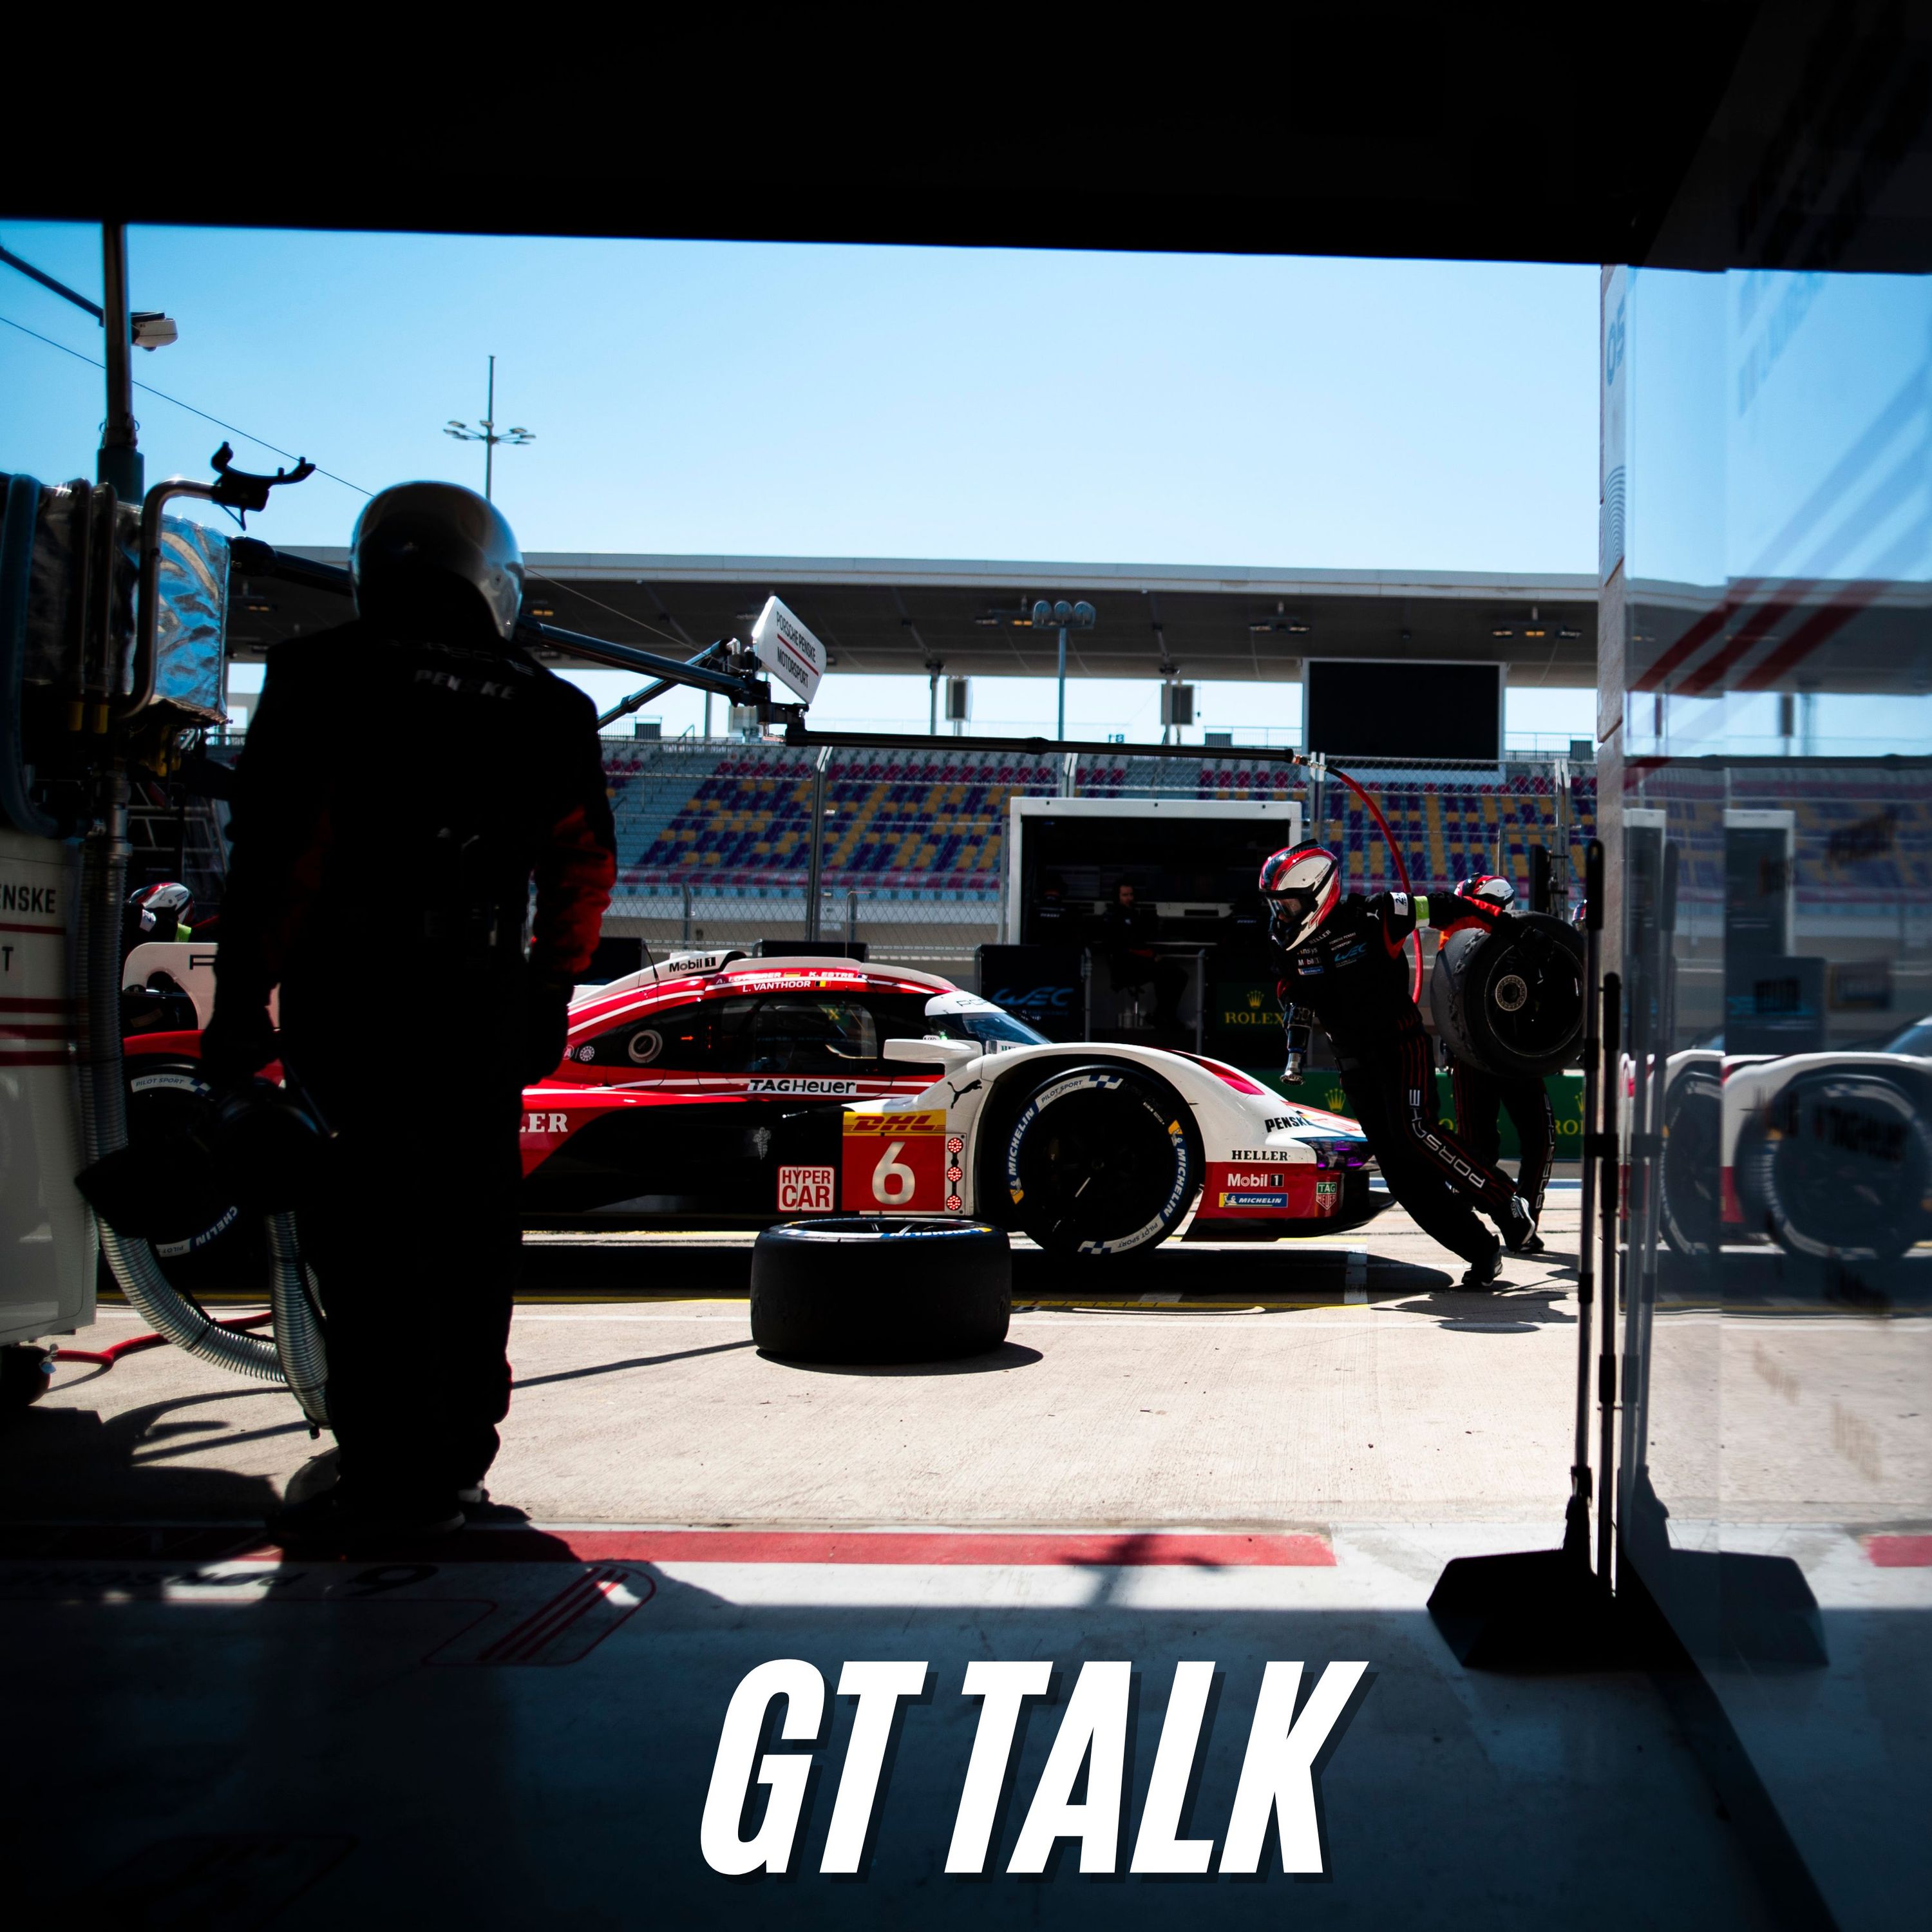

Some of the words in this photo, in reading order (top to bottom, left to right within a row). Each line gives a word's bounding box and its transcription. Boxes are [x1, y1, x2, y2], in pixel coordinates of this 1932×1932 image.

[777, 611, 799, 647] PORSCHE
[799, 632, 816, 663] PENSKE
[777, 646, 809, 688] MOTORSPORT
[0, 883, 57, 913] NSKE
[1, 946, 14, 971] T
[1334, 942, 1367, 961] WEC
[669, 958, 703, 972] Mobil
[728, 972, 782, 983] LORER
[753, 981, 811, 991] VANTHOOR
[992, 985, 1075, 1007] WEC
[136, 1078, 156, 1086] PILOT
[1041, 1088, 1058, 1103] PILOT
[1060, 1080, 1083, 1091] SPORT
[853, 1115, 935, 1131] DHL
[1265, 1116, 1312, 1133] PENSK
[1009, 1107, 1034, 1176] MICHELIN
[1408, 1089, 1486, 1189] PORSCHE
[1232, 1150, 1288, 1161] HELLER
[782, 1170, 831, 1184] HYPER
[872, 1141, 915, 1205] 6
[1227, 1173, 1267, 1187] Mobil
[1163, 1148, 1186, 1218] MICHELIN
[1318, 1184, 1336, 1193] TAG
[782, 1186, 830, 1208] CAR
[1318, 1195, 1336, 1208] HEUER
[1142, 1222, 1158, 1238] PILOT
[1117, 1236, 1140, 1248] SPORT
